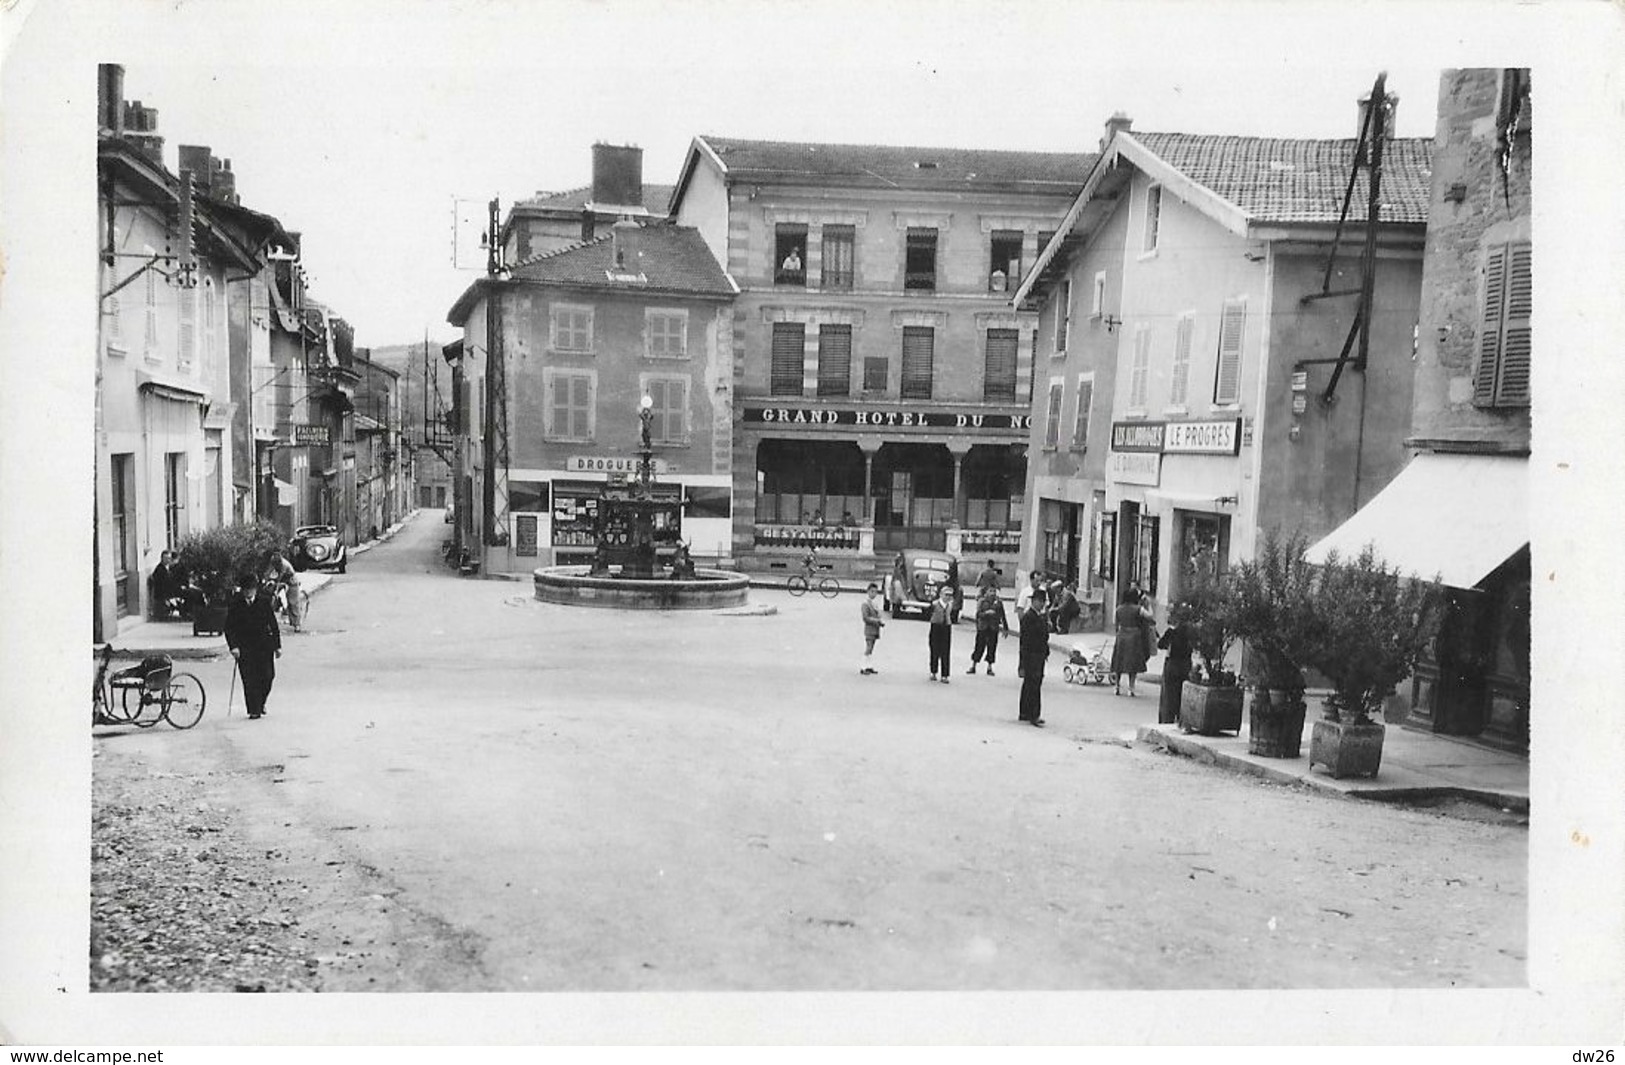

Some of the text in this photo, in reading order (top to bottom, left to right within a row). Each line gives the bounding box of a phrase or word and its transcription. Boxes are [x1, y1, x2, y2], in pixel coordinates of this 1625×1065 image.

[762, 409, 839, 424] GRAND
[855, 411, 929, 426] HOTEL
[956, 414, 984, 427] DU
[1170, 426, 1182, 446] LE
[1185, 425, 1230, 447] PROGRES
[577, 459, 656, 471] DROGUERE
